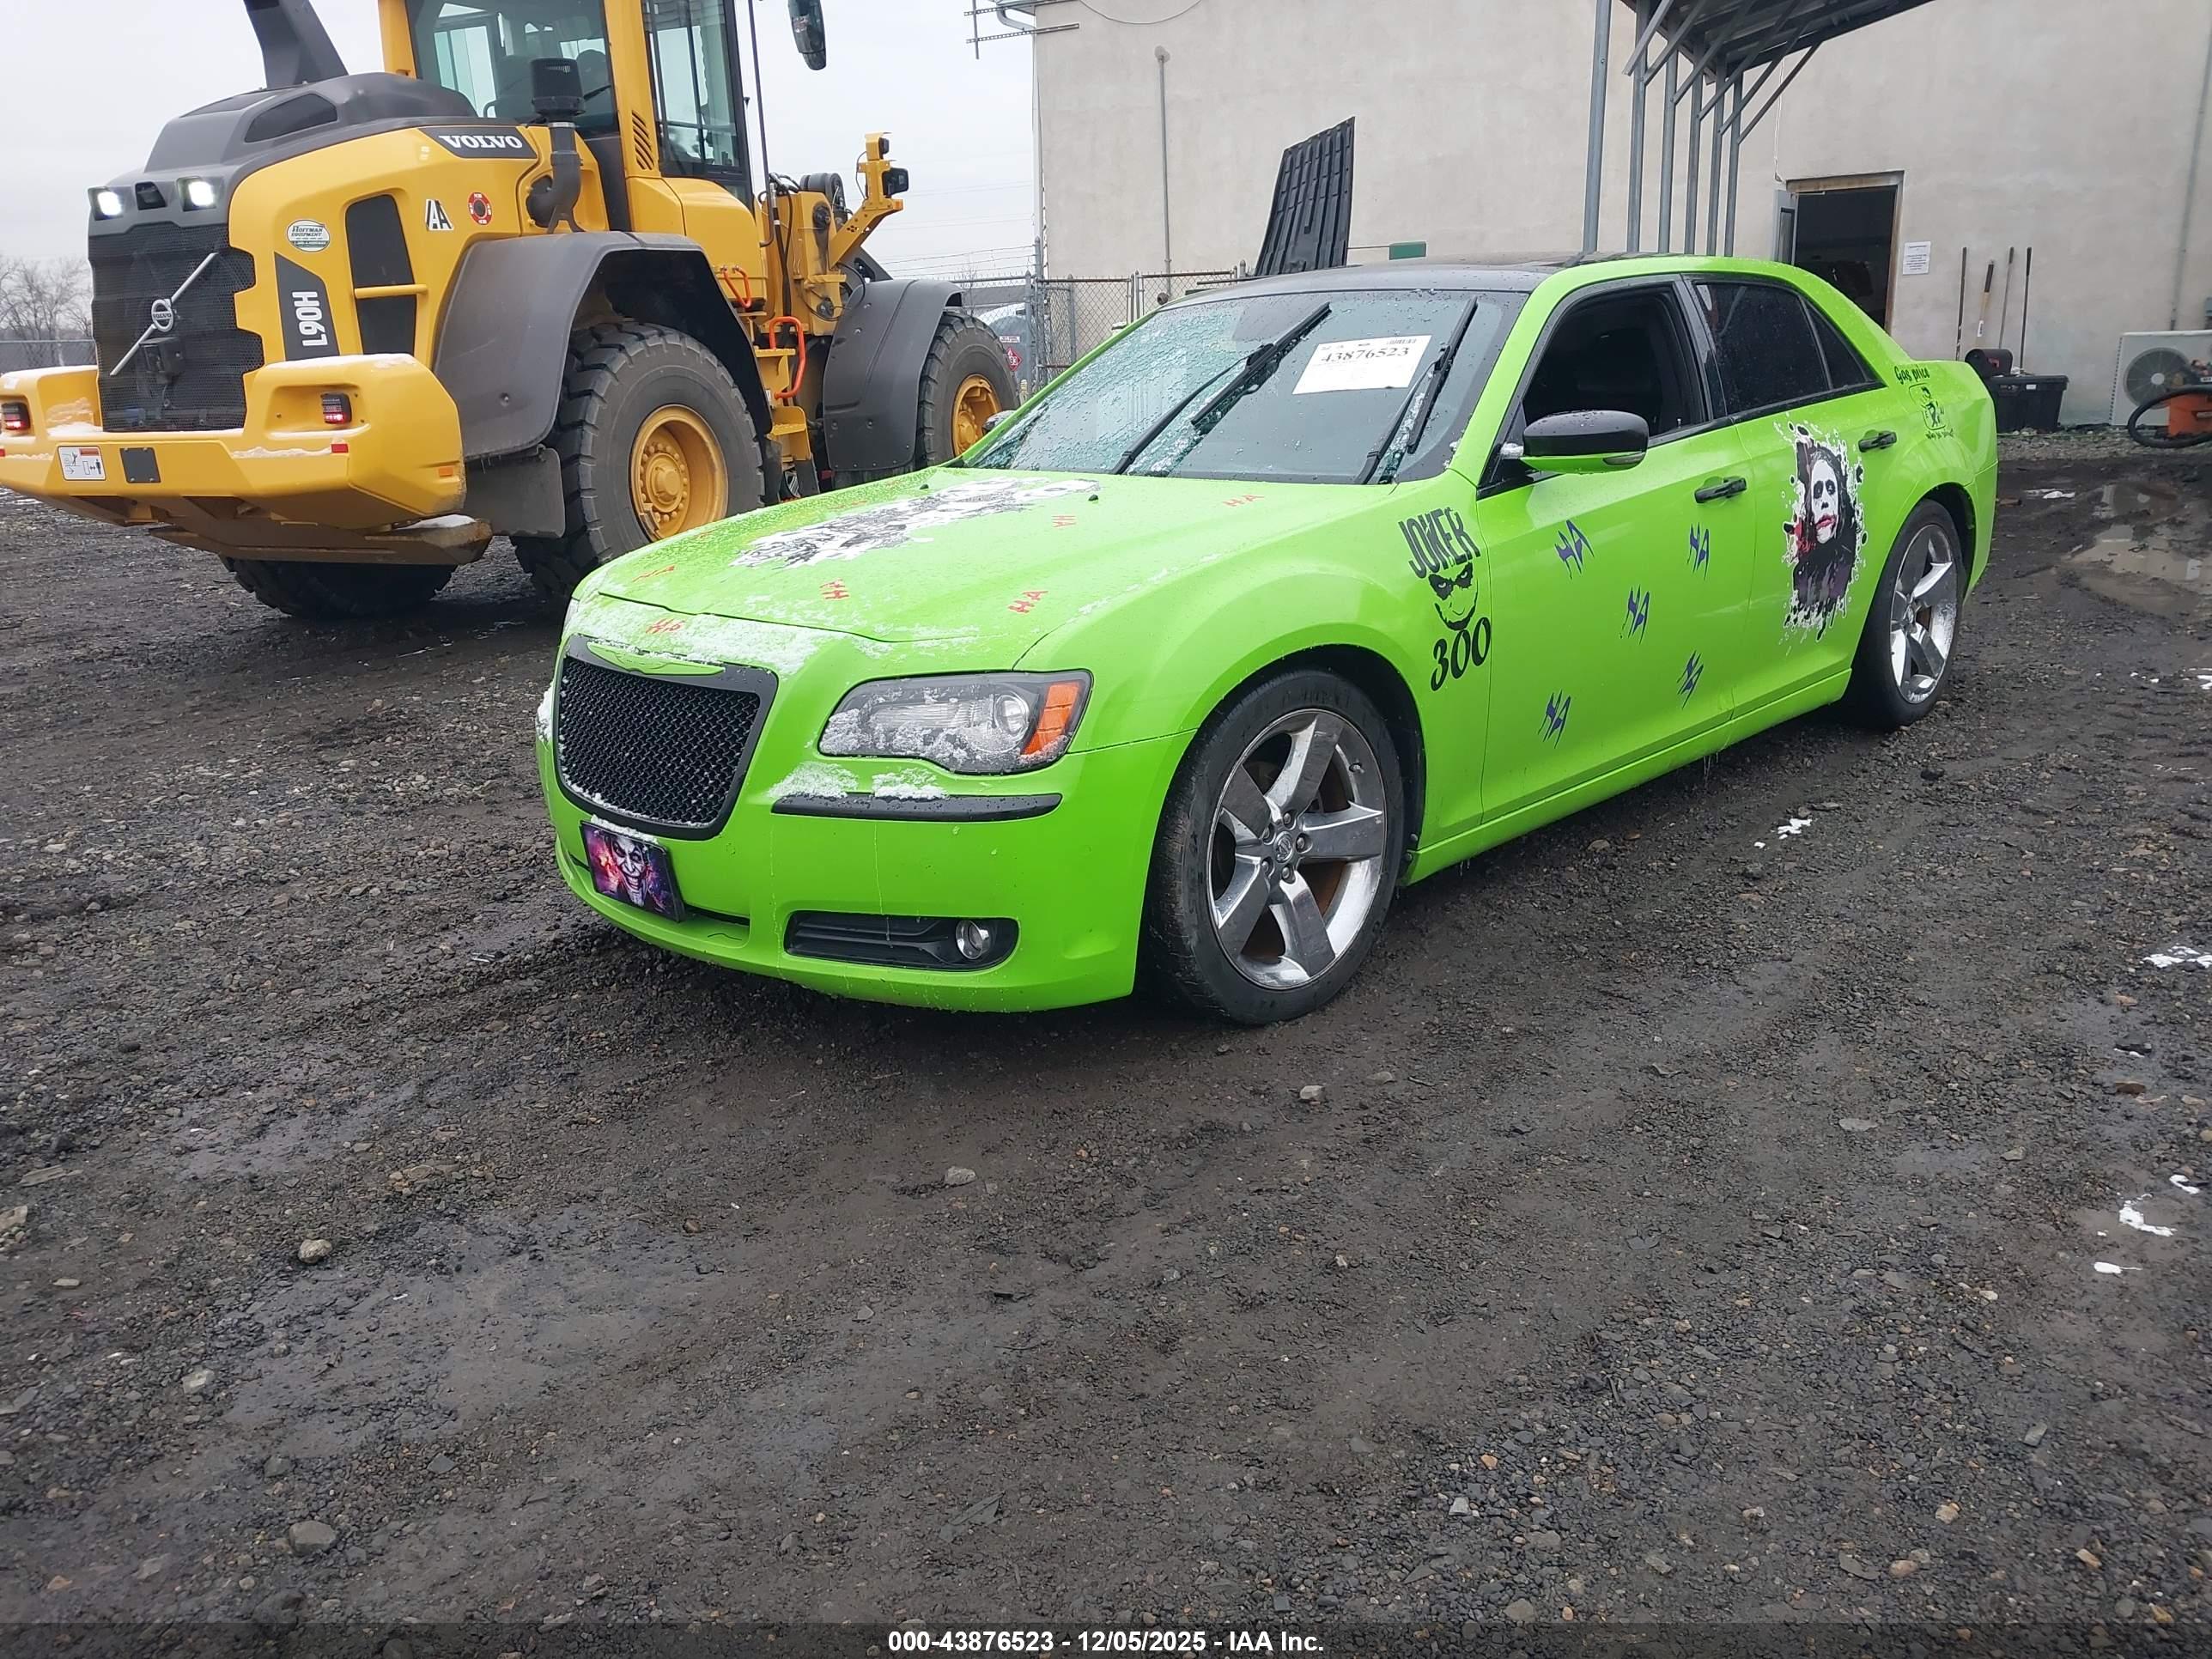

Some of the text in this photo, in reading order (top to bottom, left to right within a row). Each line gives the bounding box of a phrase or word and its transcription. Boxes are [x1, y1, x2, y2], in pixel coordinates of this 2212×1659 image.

[438, 135, 523, 149] VOLVO
[292, 291, 328, 347] L90H
[1321, 347, 1410, 363] 43876523
[1893, 366, 1912, 385] Gas
[1398, 507, 1481, 579] JOKER
[1430, 617, 1491, 691] 300
